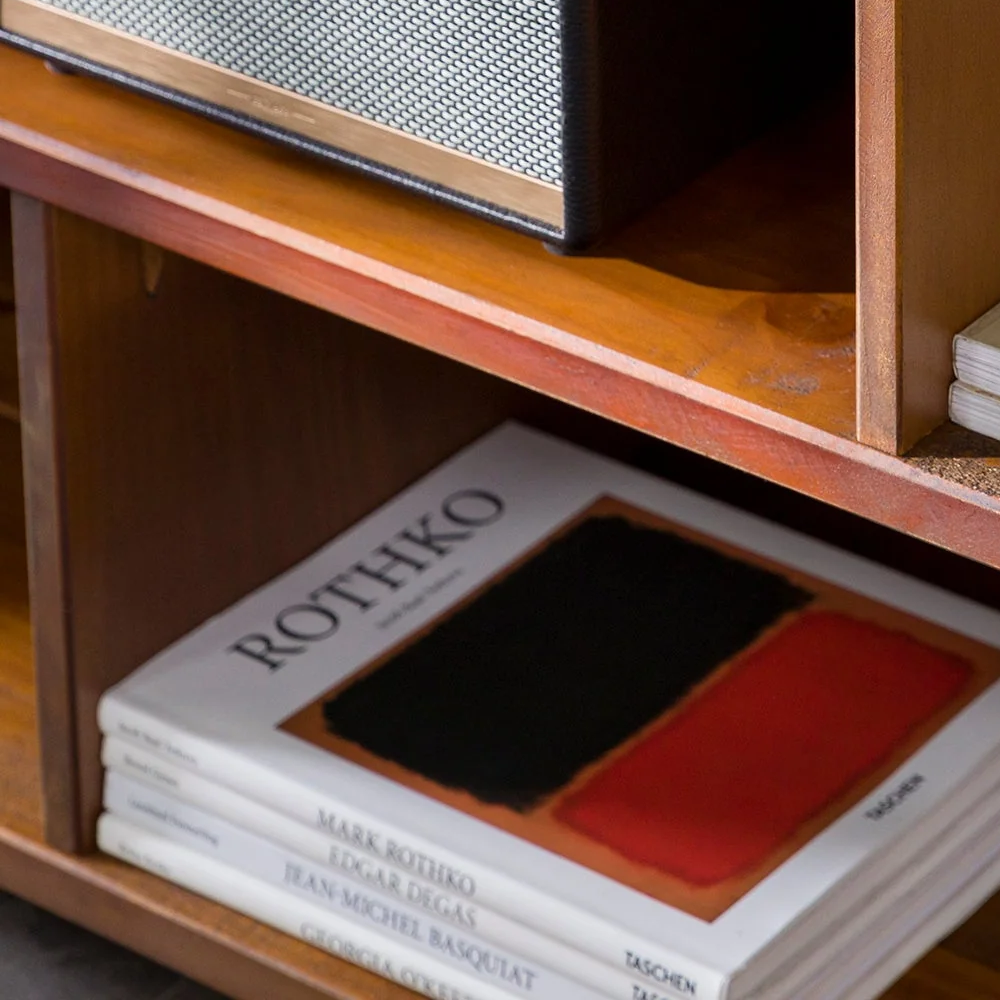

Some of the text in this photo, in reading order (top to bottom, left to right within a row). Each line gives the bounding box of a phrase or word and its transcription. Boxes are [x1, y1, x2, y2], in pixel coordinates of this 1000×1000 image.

[228, 488, 506, 673] ROTHKO
[864, 773, 925, 821] TASCHEN
[316, 807, 477, 898] MARK ROTHKO
[328, 845, 477, 931] EDGAR DEGAS
[284, 861, 539, 991] JEAN-MICHEL BASQUIAT
[299, 921, 395, 978] GEORGIA
[625, 949, 697, 995] TASCHEN
